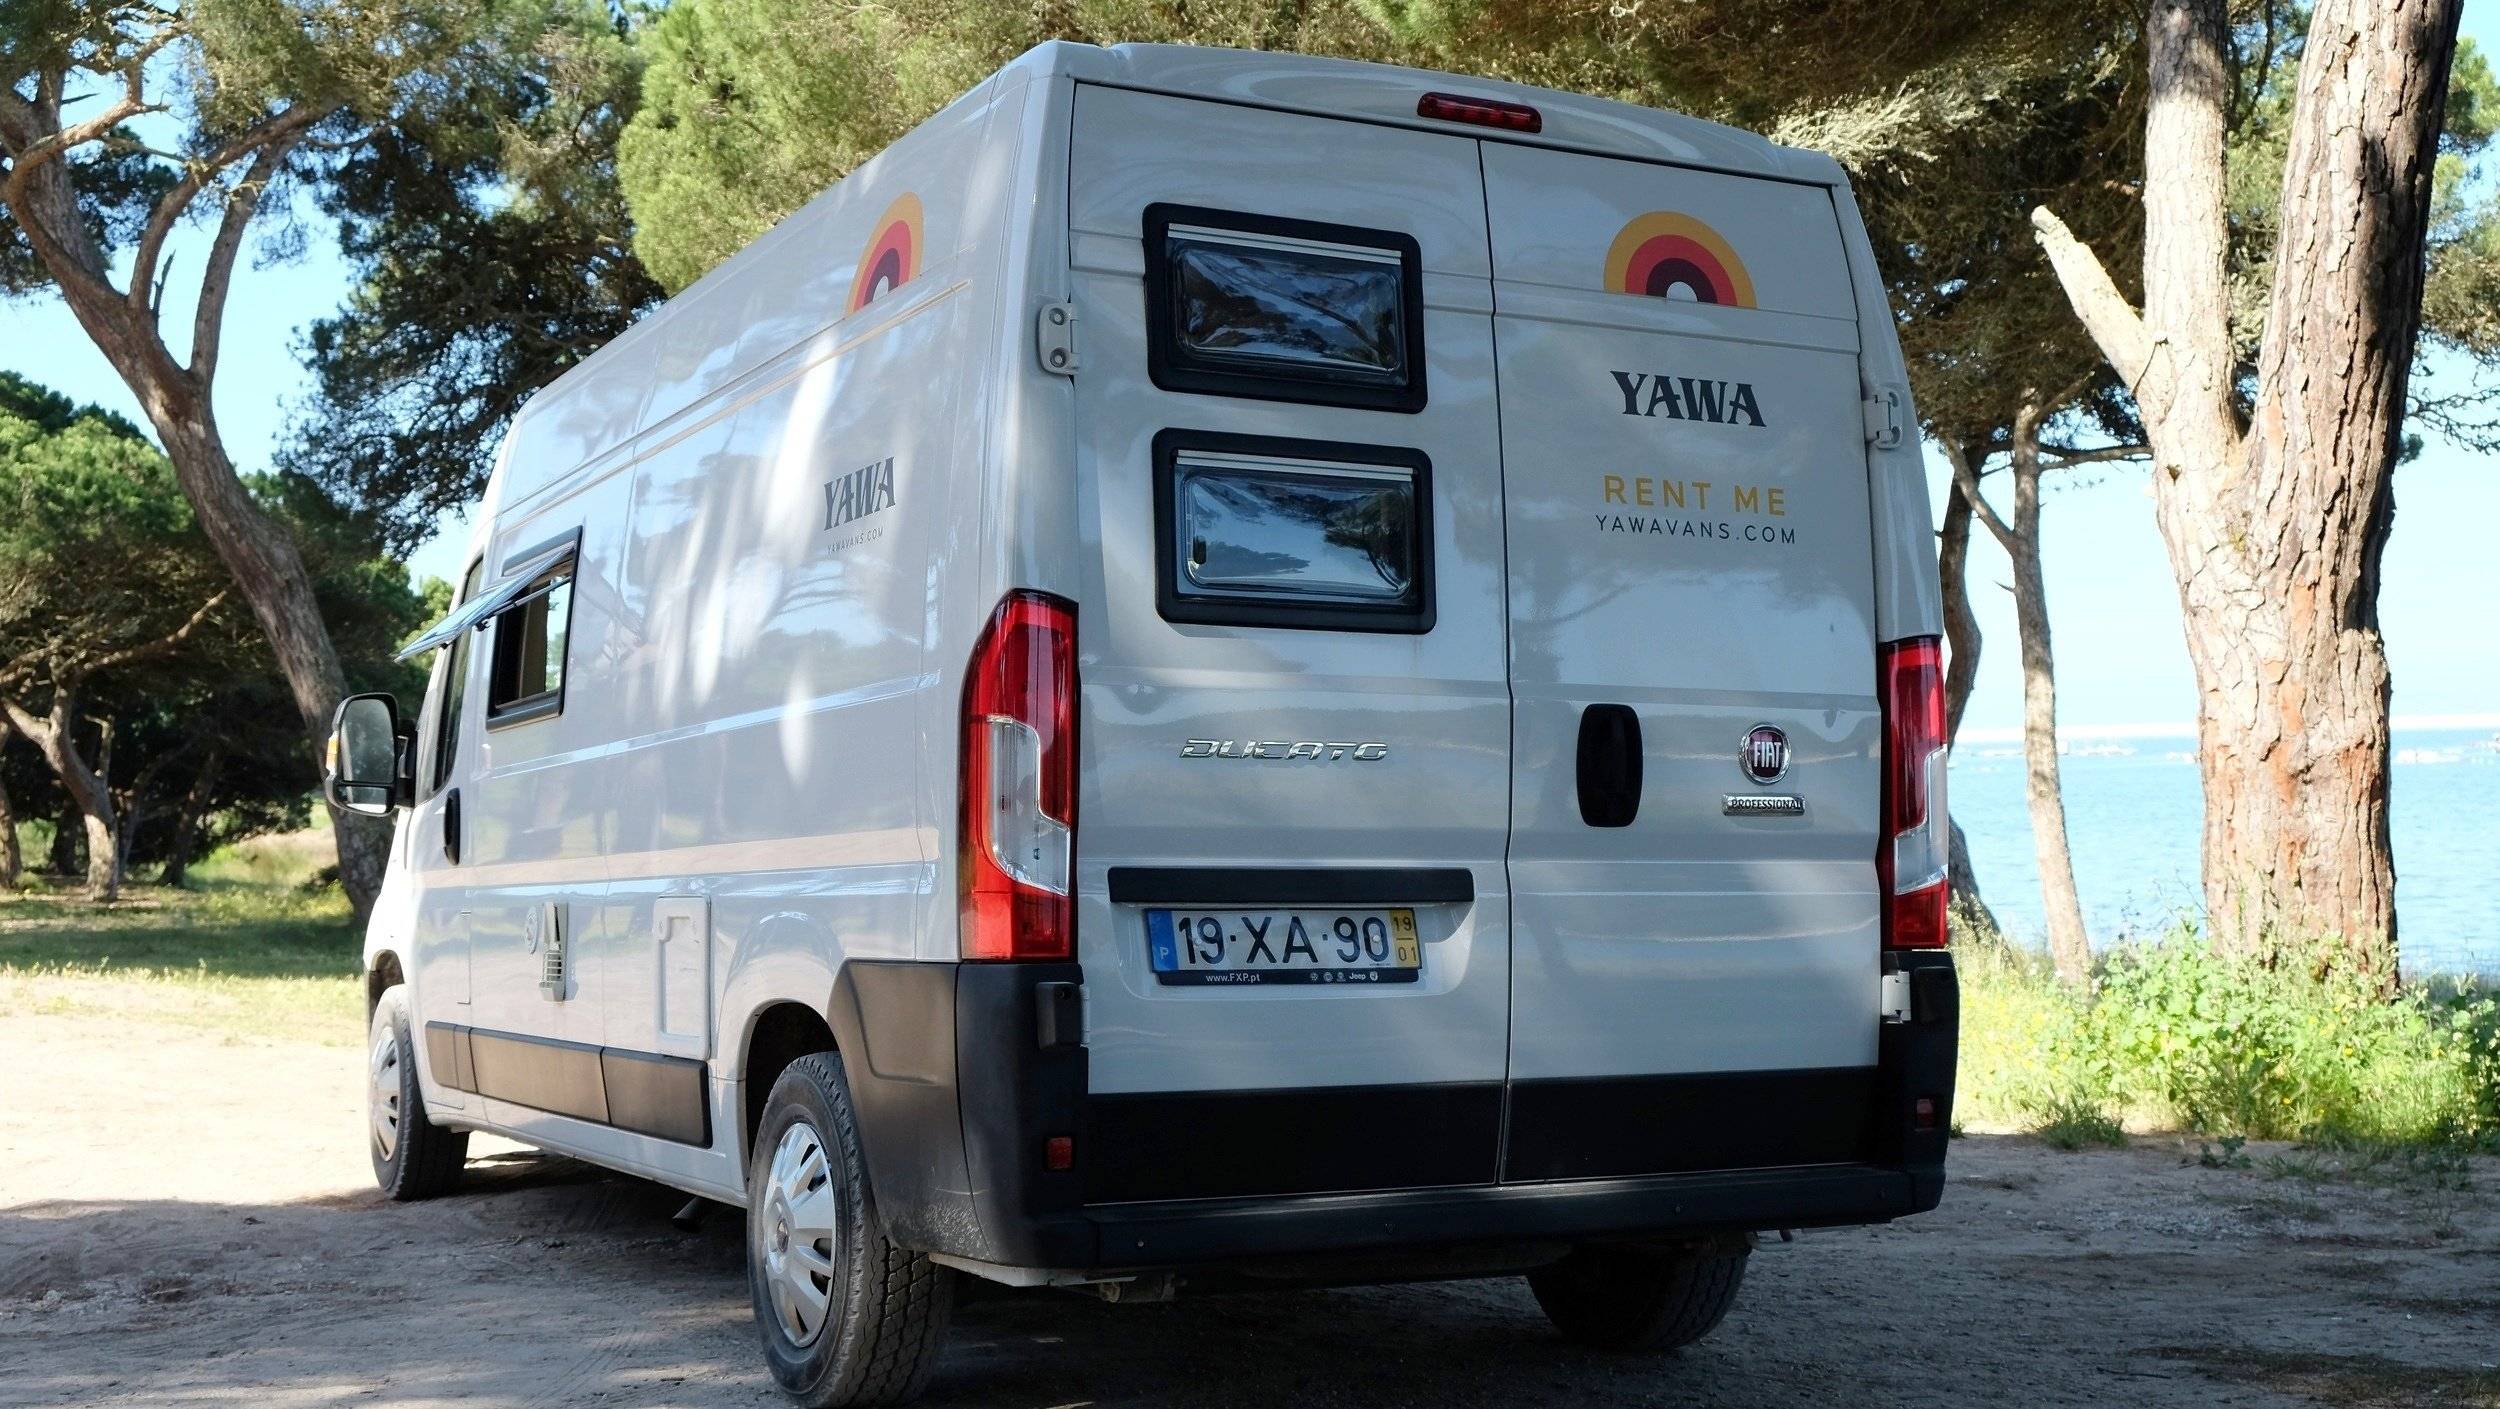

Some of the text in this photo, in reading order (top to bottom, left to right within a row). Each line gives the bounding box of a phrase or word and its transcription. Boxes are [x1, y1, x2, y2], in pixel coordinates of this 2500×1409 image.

[1609, 370, 1767, 428] YAWA
[823, 456, 896, 532] YAWA
[1603, 474, 1786, 517] RENT ME
[1595, 514, 1796, 545] YAWAVANS.COM
[1179, 738, 1390, 761] DUCATO
[1753, 741, 1782, 768] FIAT
[1730, 798, 1801, 811] PROFESSIONAL
[1393, 916, 1412, 932] 19
[1158, 947, 1170, 960] P
[1397, 946, 1418, 962] 01
[1205, 973, 1261, 984] www.FXP.pt
[1348, 972, 1367, 981] Jeep
